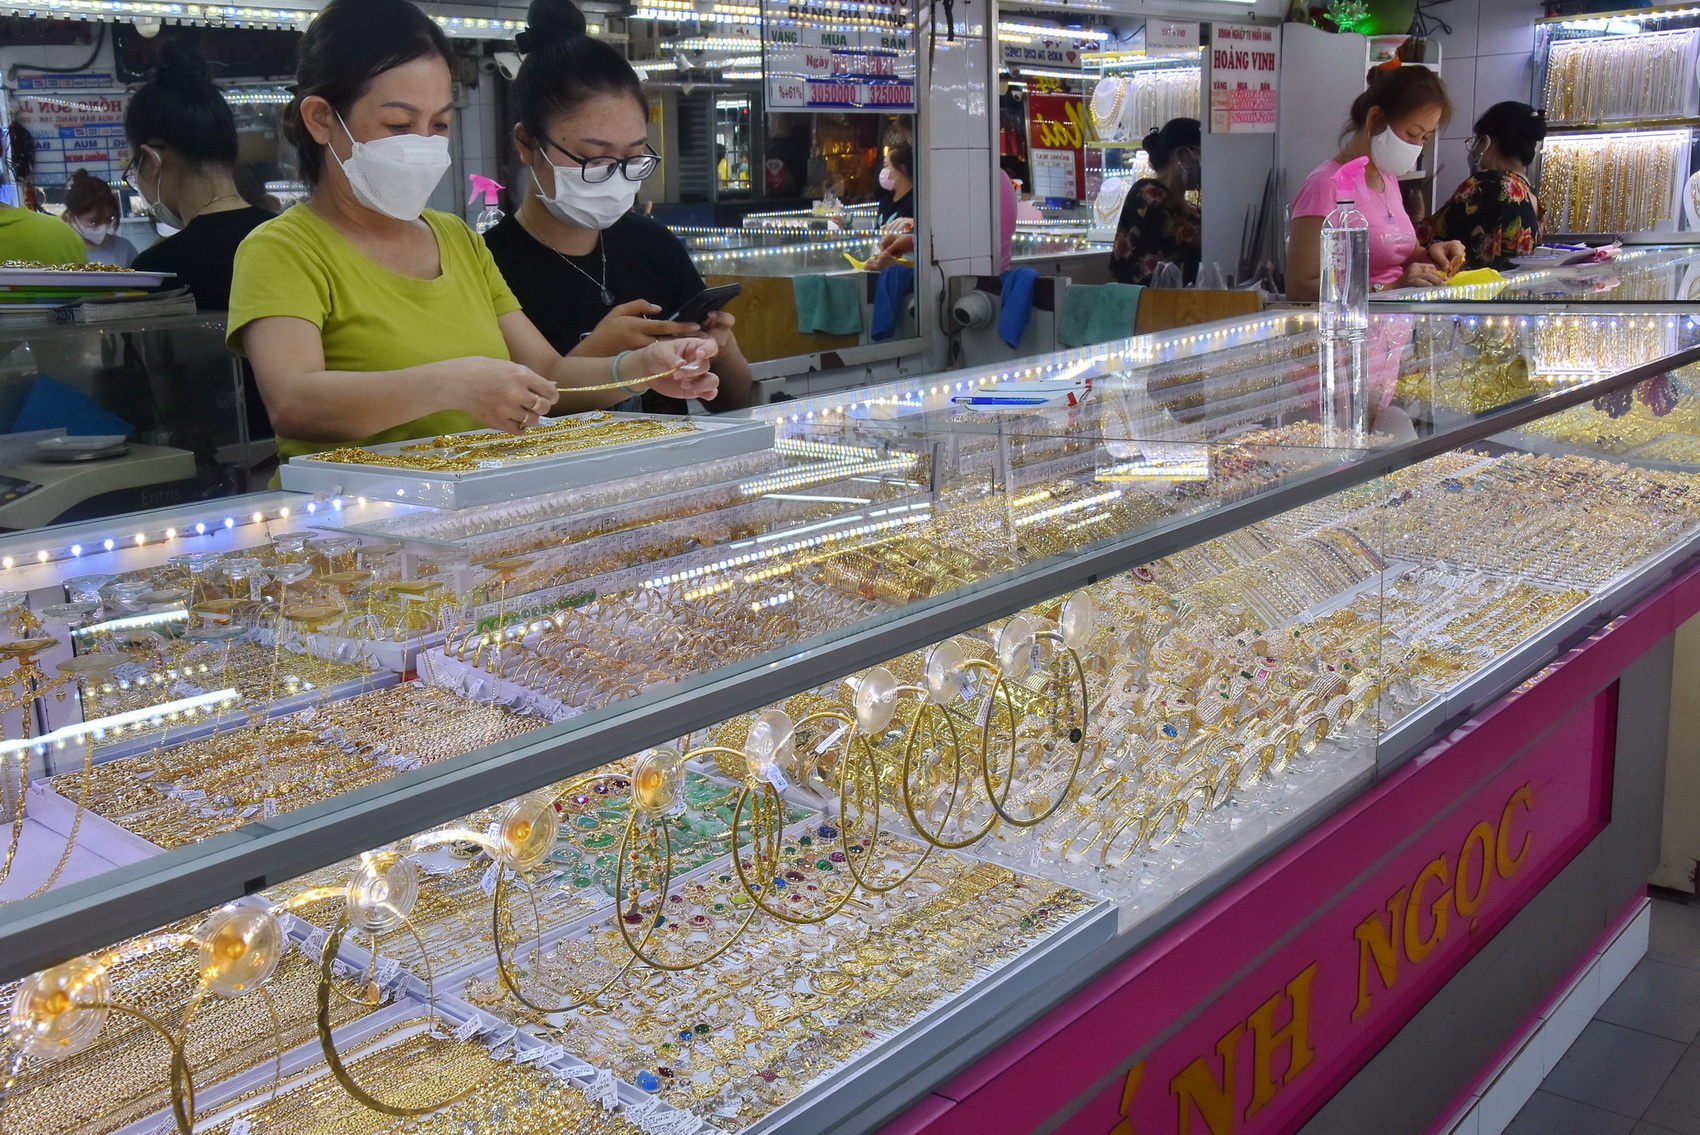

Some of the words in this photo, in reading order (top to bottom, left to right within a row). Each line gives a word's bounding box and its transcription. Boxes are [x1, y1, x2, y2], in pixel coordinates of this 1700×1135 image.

[771, 28, 798, 43] VÀNG
[821, 33, 847, 46] MUA
[881, 35, 907, 49] BÁN
[806, 54, 830, 68] Ngày
[1213, 45, 1249, 70] HOÀNG
[1252, 52, 1275, 71] VINH
[811, 84, 856, 102] 3050000
[869, 85, 911, 103] 3250000
[141, 487, 181, 505] Entris
[1350, 781, 1533, 1024] NGỌC
